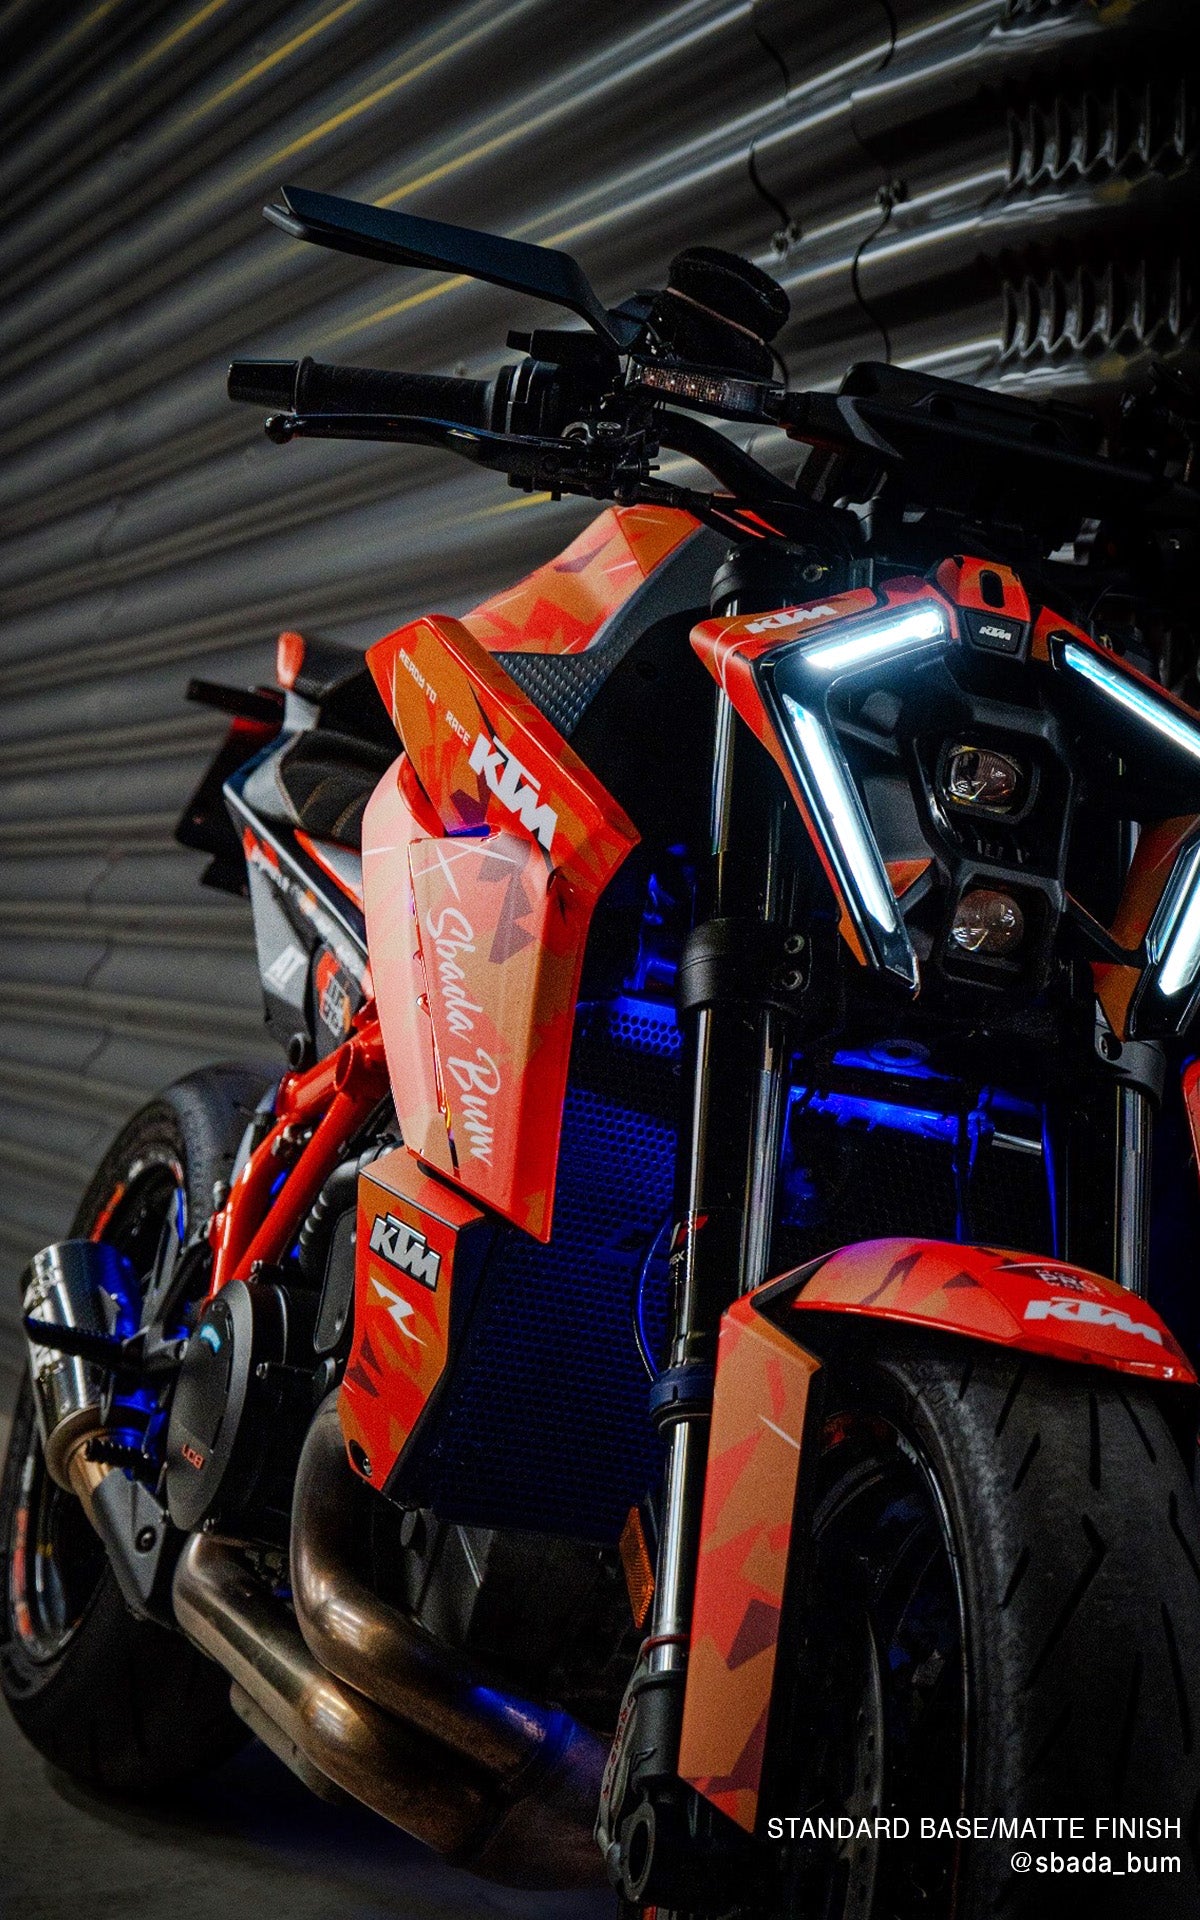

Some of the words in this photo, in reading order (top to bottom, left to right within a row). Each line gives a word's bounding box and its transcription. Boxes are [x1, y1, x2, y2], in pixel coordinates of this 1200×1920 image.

[744, 604, 837, 635] KTM
[979, 625, 1012, 642] KTM
[399, 647, 426, 689] READY
[425, 684, 438, 704] TO
[445, 710, 471, 747] RACE
[468, 732, 558, 852] KTM
[446, 1047, 501, 1168] Bum
[369, 1212, 442, 1290] KTM
[1024, 1296, 1163, 1346] KTM
